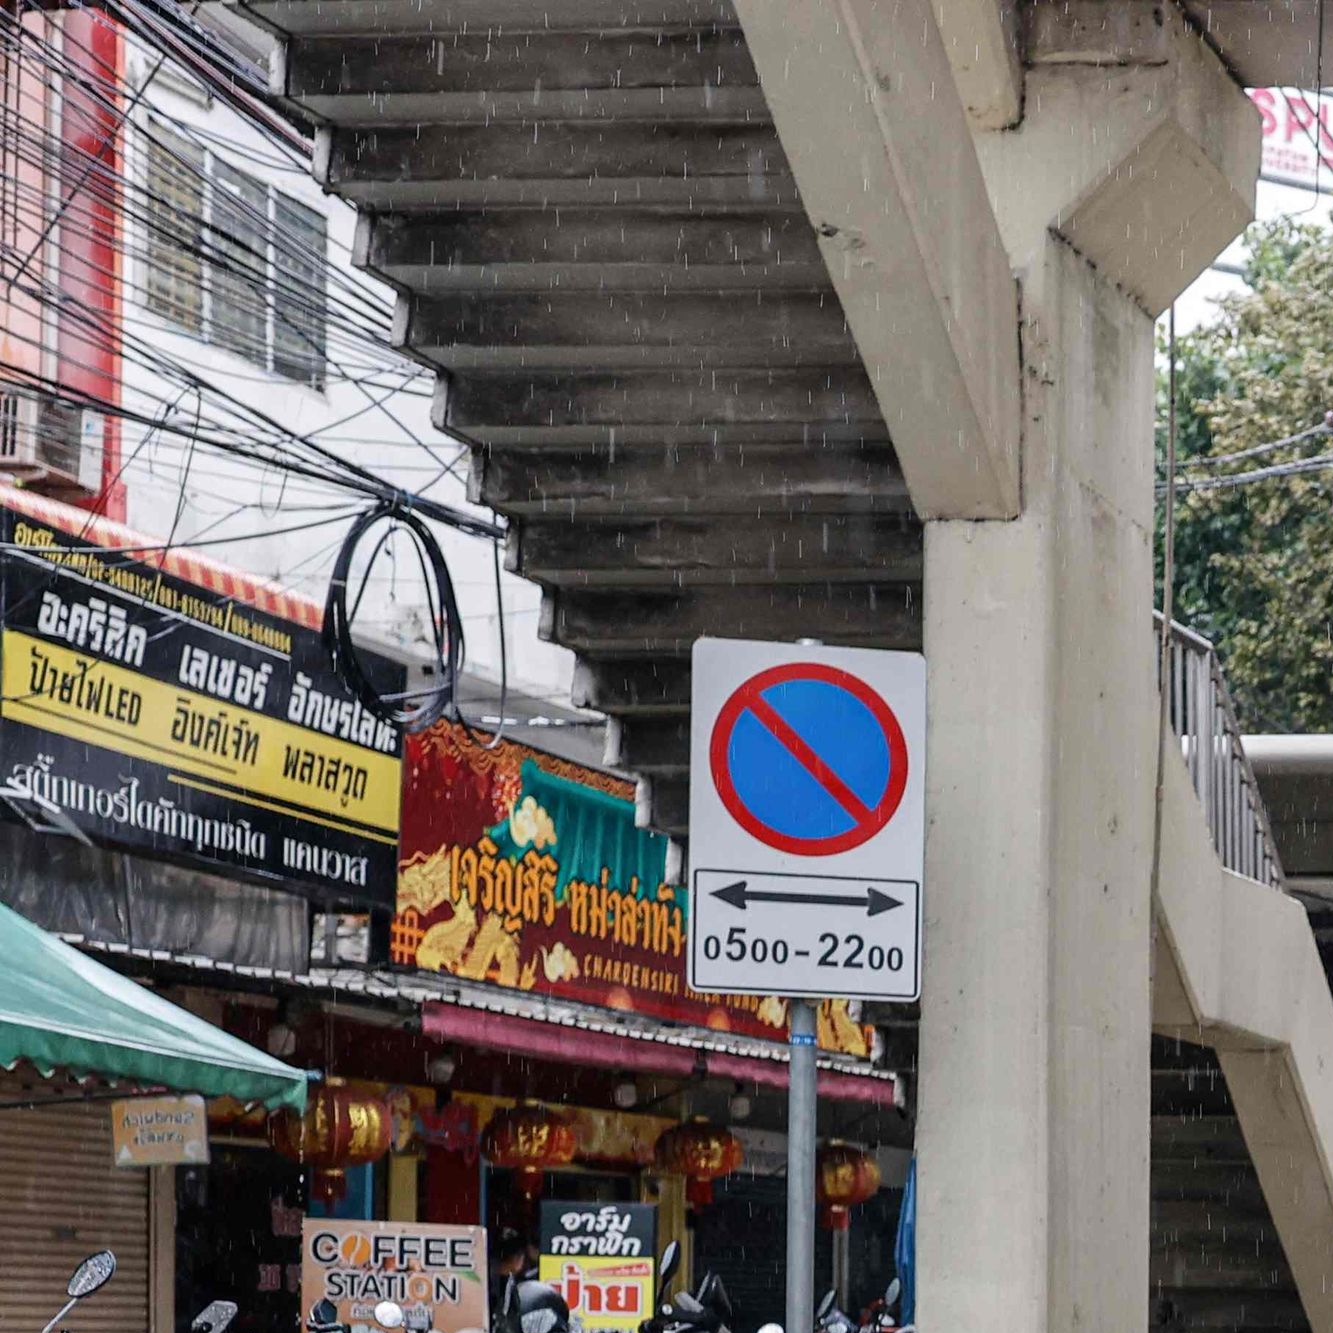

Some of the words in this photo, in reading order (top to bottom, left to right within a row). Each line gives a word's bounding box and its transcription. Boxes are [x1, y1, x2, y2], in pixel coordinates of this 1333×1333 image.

[282, 744, 369, 808] พลาสวูด
[283, 836, 370, 887] แคนวาส
[560, 1206, 632, 1233] อาร์ม
[311, 1232, 474, 1269] COFFEE
[325, 1271, 459, 1302] STATION
